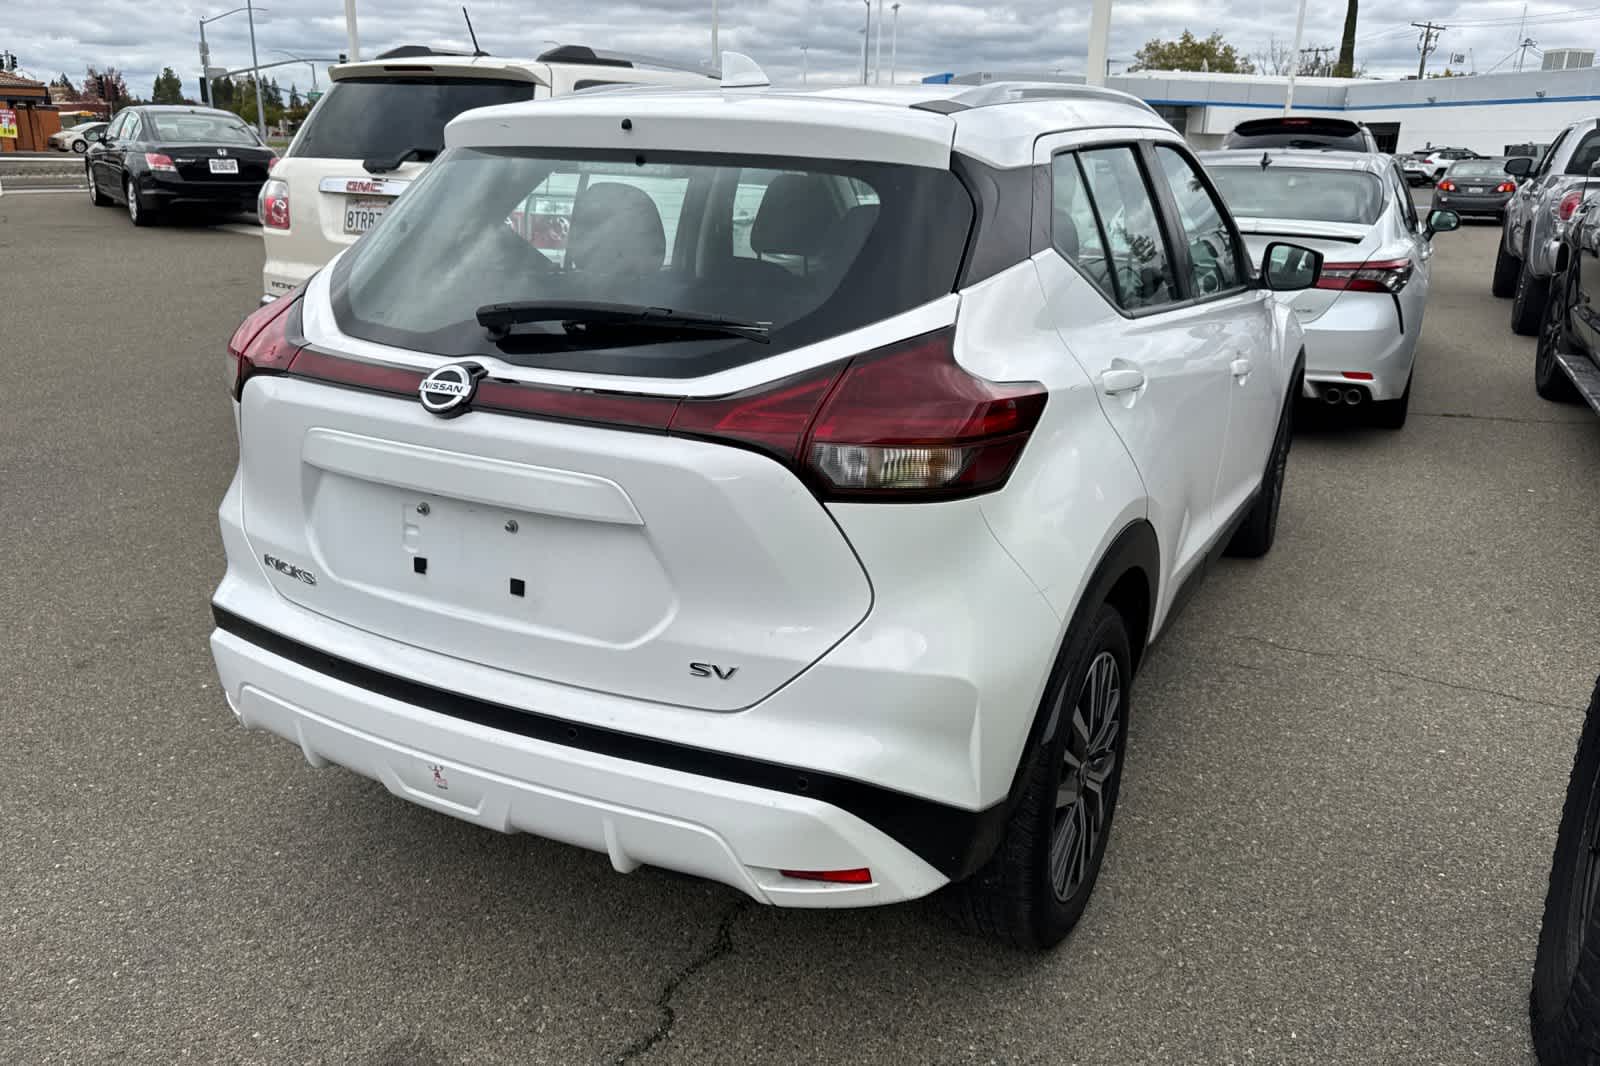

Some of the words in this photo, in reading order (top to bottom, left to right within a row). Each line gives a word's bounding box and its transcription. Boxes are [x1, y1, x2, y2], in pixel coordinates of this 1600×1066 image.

[346, 181, 384, 193] GMC
[422, 381, 463, 394] NISSAN
[263, 553, 316, 586] KICKS
[690, 662, 739, 680] SV
